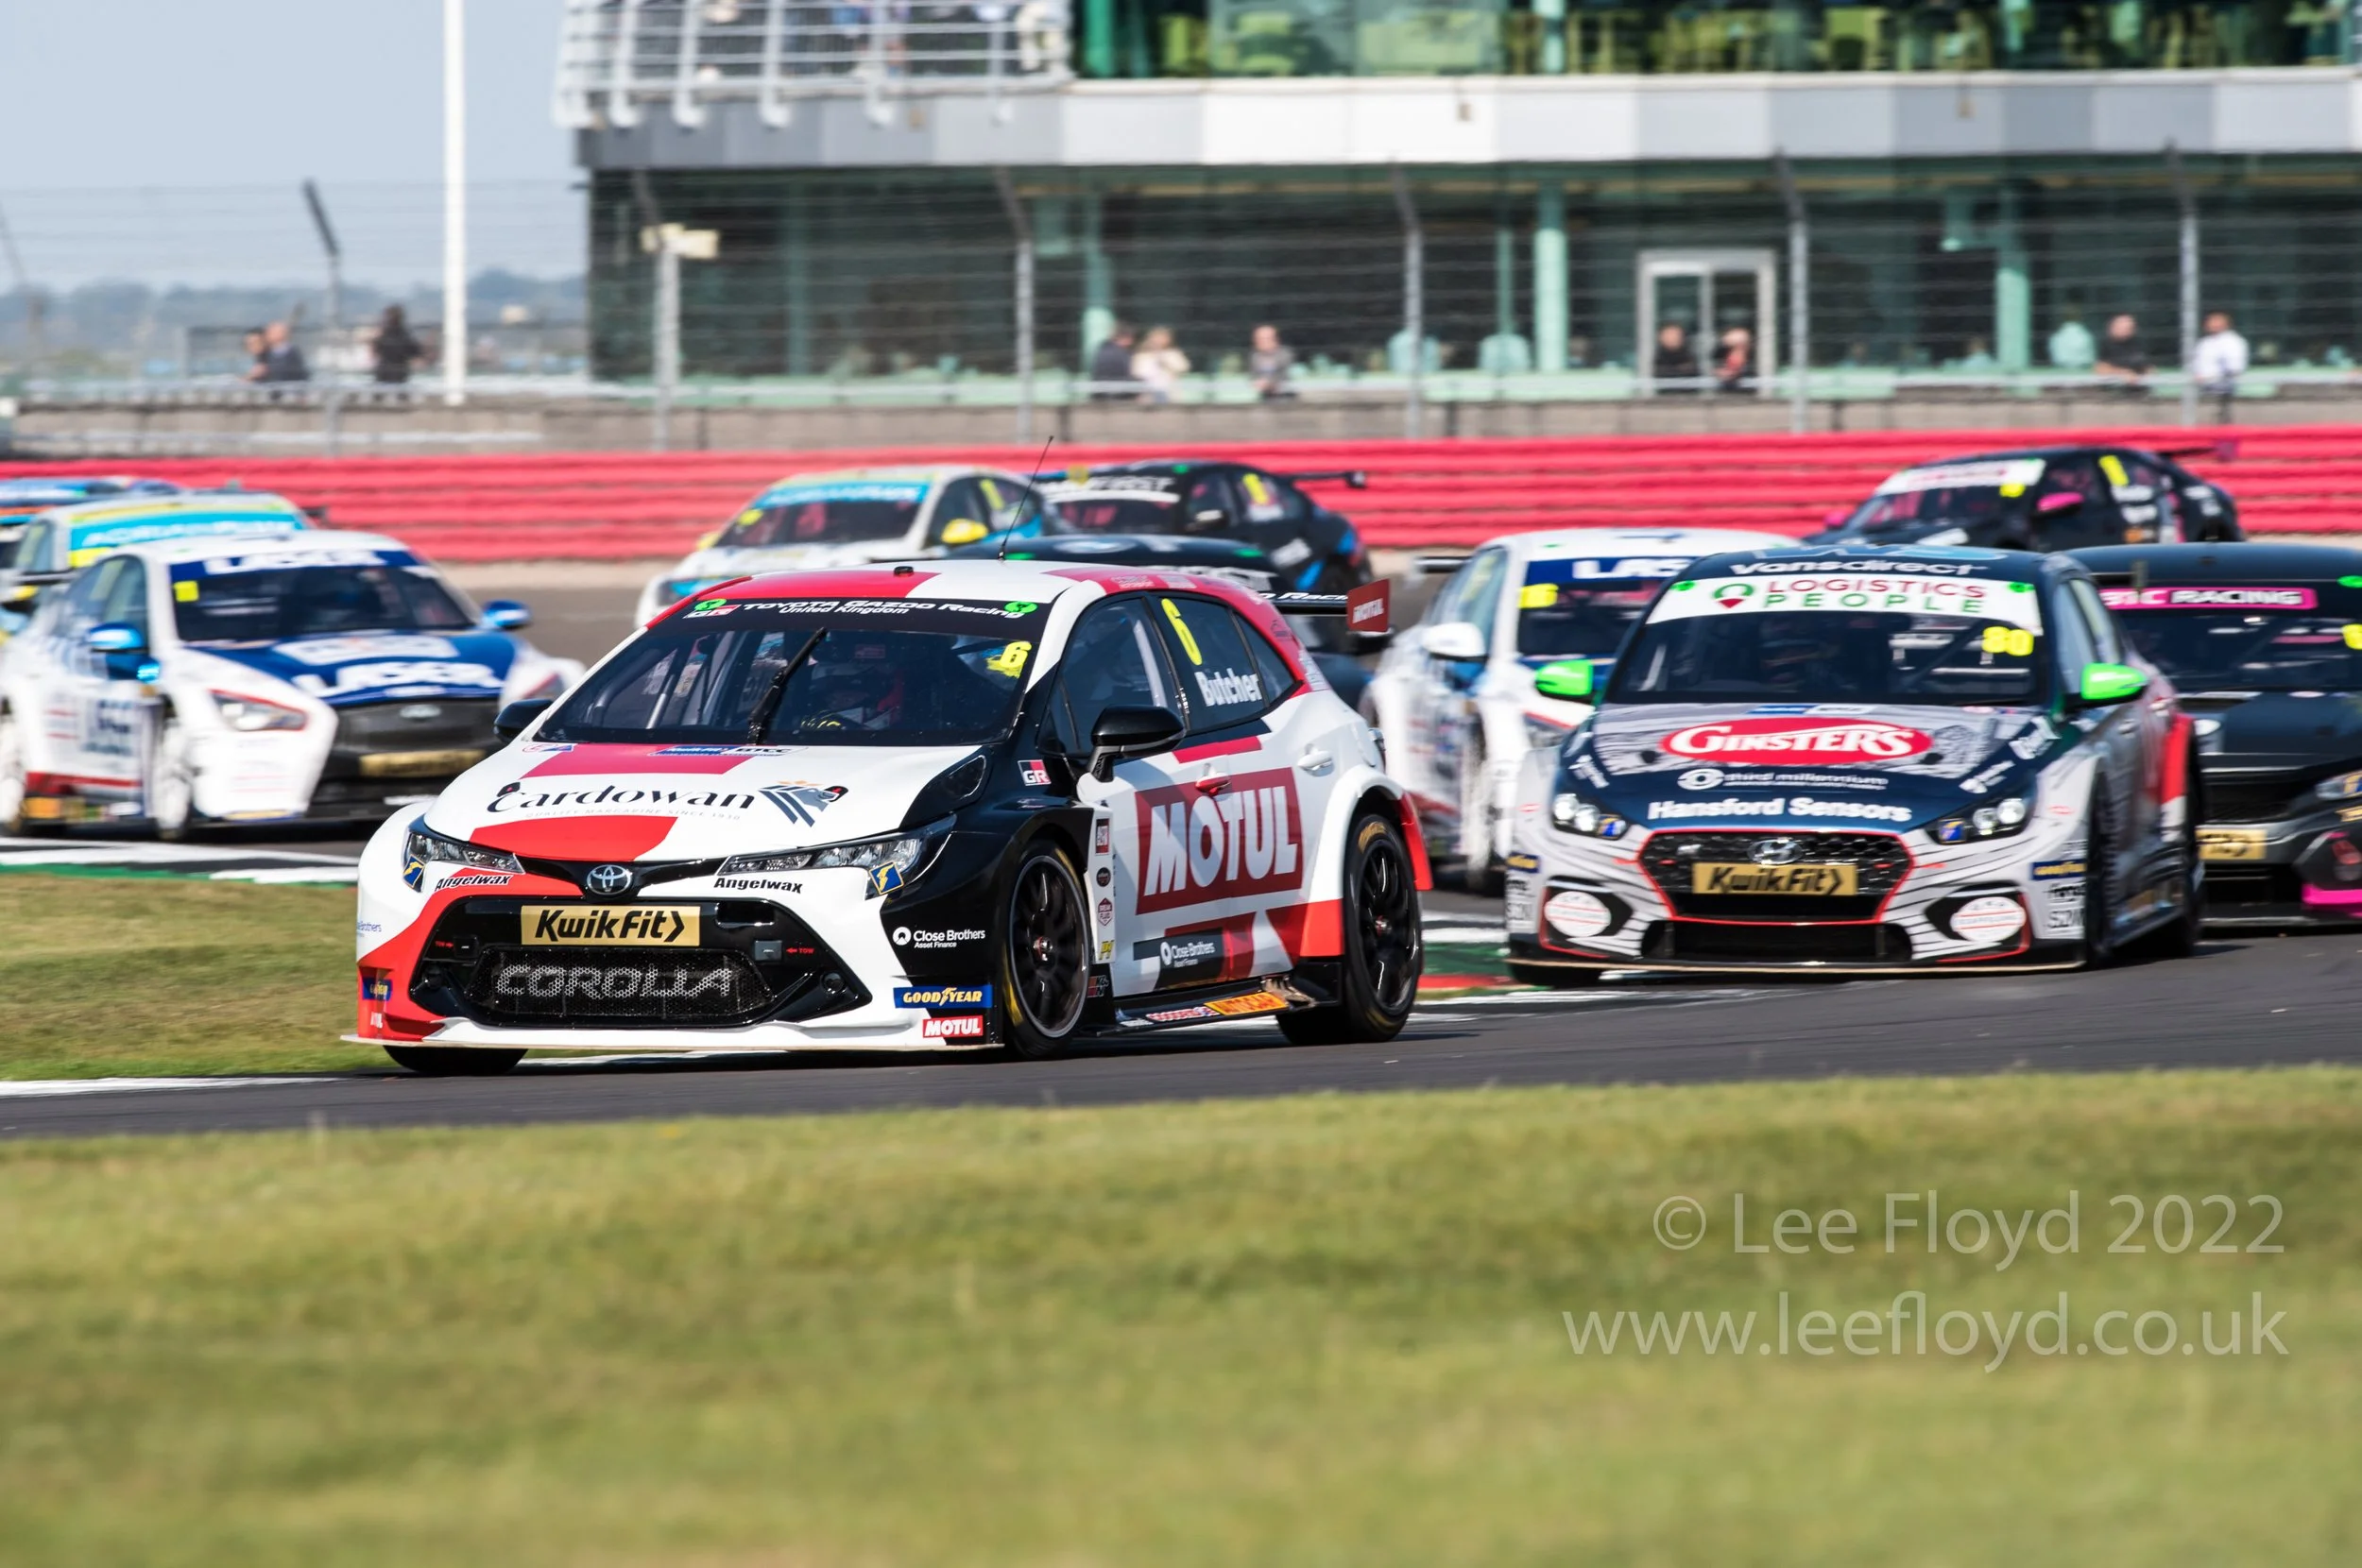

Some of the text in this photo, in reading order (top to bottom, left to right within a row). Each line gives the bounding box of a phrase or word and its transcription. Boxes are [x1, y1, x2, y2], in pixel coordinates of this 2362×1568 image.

[1768, 579, 1986, 598] LOGISTICS
[2169, 589, 2303, 605] RACING
[744, 600, 1026, 619] TOYOTA GAZOO Racing
[779, 605, 911, 615] United Kingdom
[1764, 592, 1984, 613] PEOPLE
[1160, 598, 1203, 666] 6
[1981, 625, 2035, 656] 80
[999, 640, 1033, 669] 6
[1193, 667, 1264, 707] Butcher
[1022, 769, 1051, 784] GR
[486, 784, 756, 813] Cardowan
[1647, 796, 1913, 822] Hansford Sensors
[1143, 785, 1298, 896] MOTUL
[434, 875, 514, 893] Angelwax
[713, 877, 802, 895] Angelwax
[913, 929, 986, 943] Close Brothers
[496, 963, 733, 1000] COROLLA
[902, 988, 984, 1005] GOODYEAR
[924, 1017, 982, 1037] MOTUL
